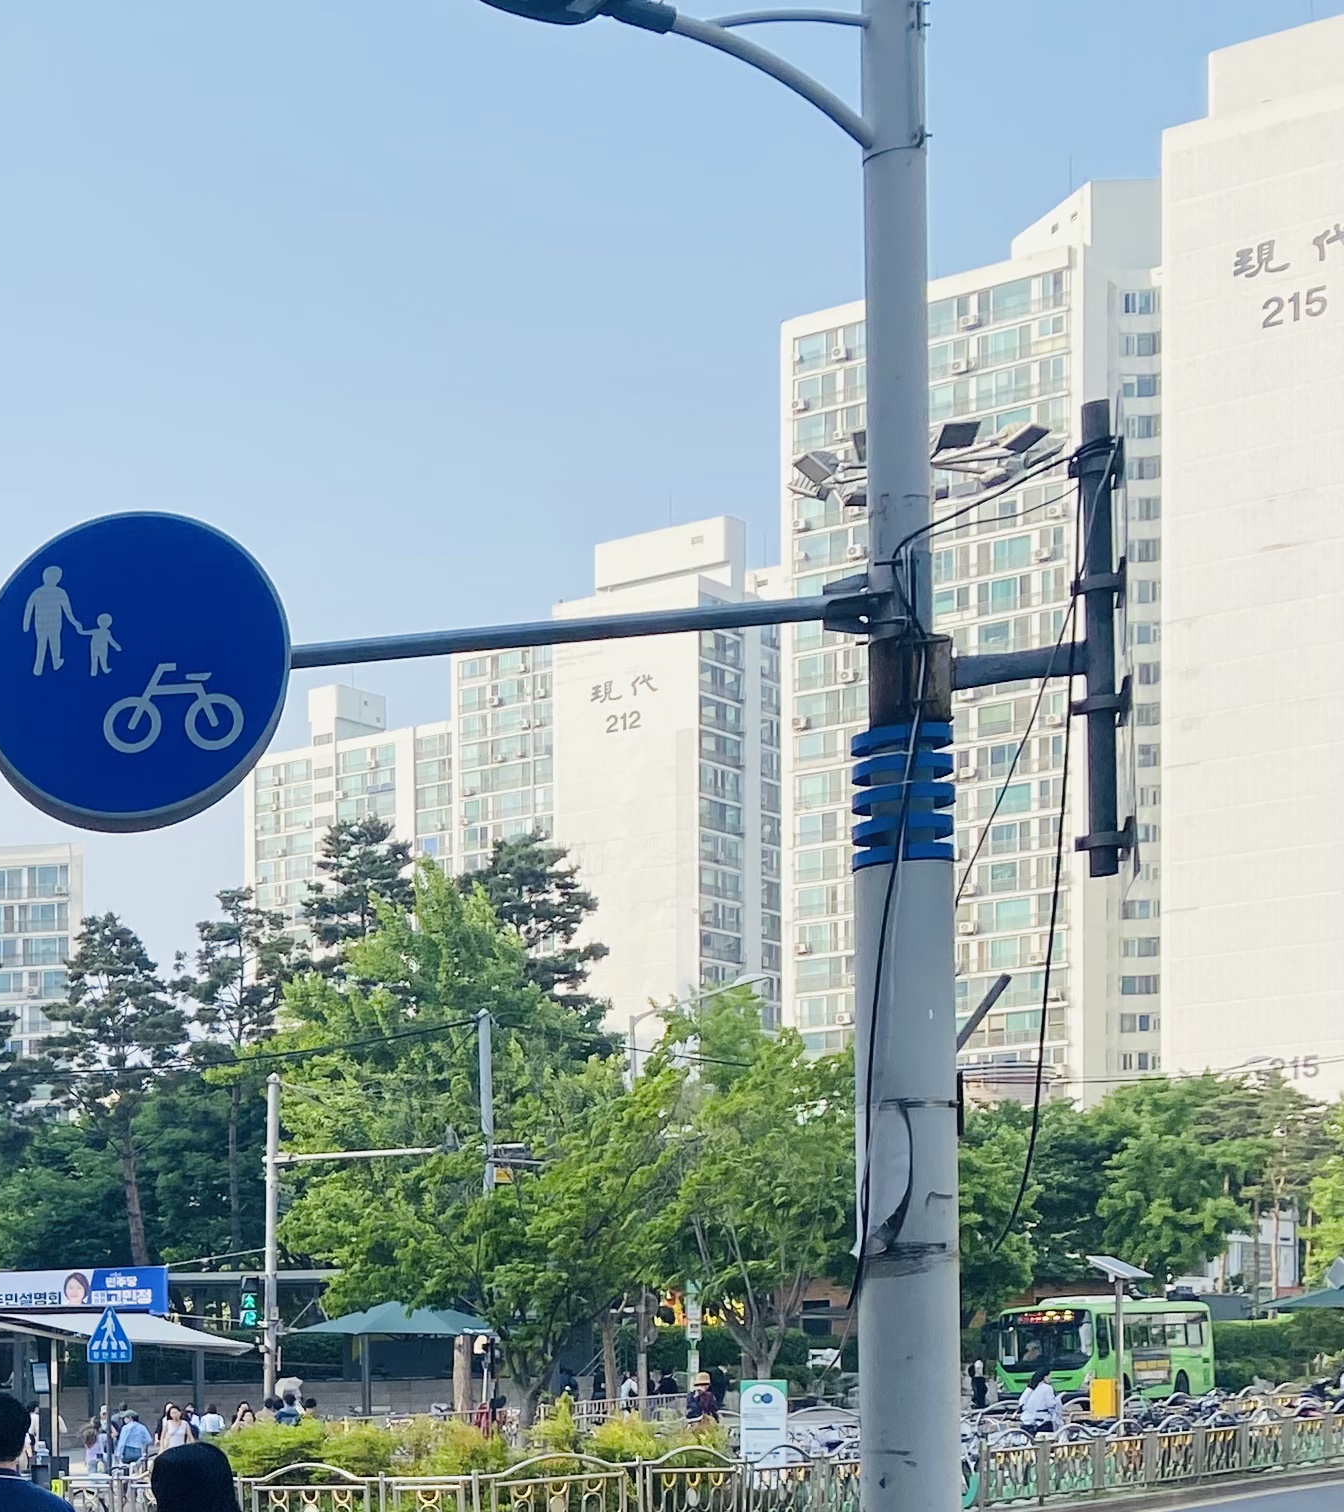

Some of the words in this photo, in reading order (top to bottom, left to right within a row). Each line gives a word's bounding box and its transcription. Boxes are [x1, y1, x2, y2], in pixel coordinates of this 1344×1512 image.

[1261, 285, 1328, 329] 215
[590, 674, 659, 704] 現代
[606, 710, 642, 734] 212
[105, 1276, 138, 1289] 민주당
[107, 1288, 153, 1306] 고민정
